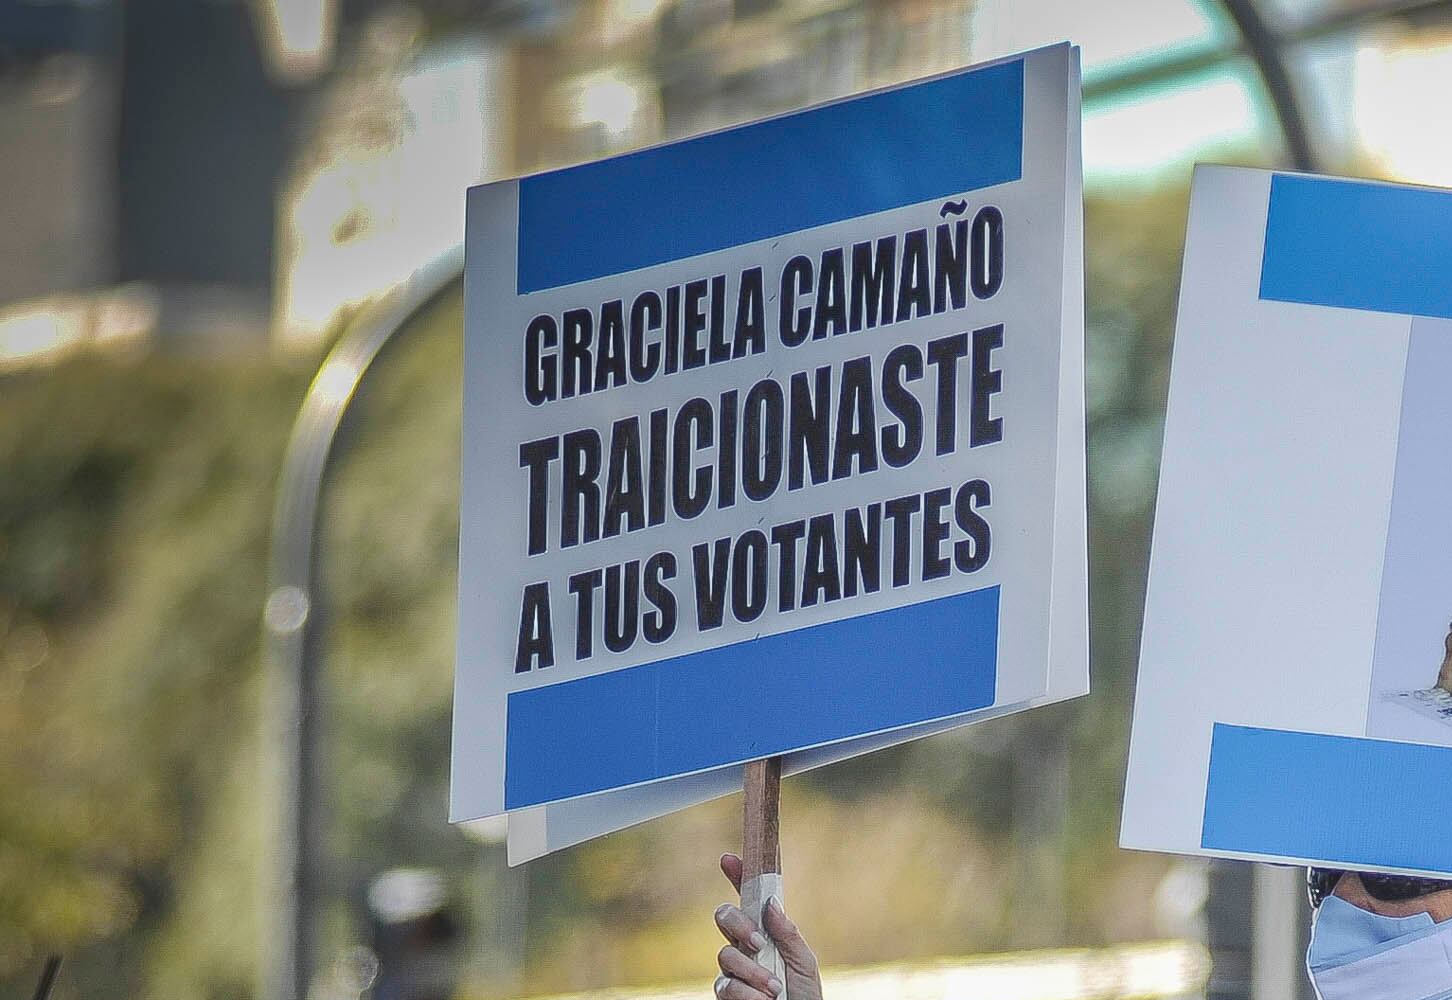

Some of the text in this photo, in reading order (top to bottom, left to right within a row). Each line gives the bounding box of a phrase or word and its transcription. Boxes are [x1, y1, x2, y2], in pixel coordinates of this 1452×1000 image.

[523, 200, 1005, 407] GRACIELA CAMAÑO
[520, 324, 1005, 556] TRAICIONASTE
[514, 479, 992, 674] A TUS VOTANTES
